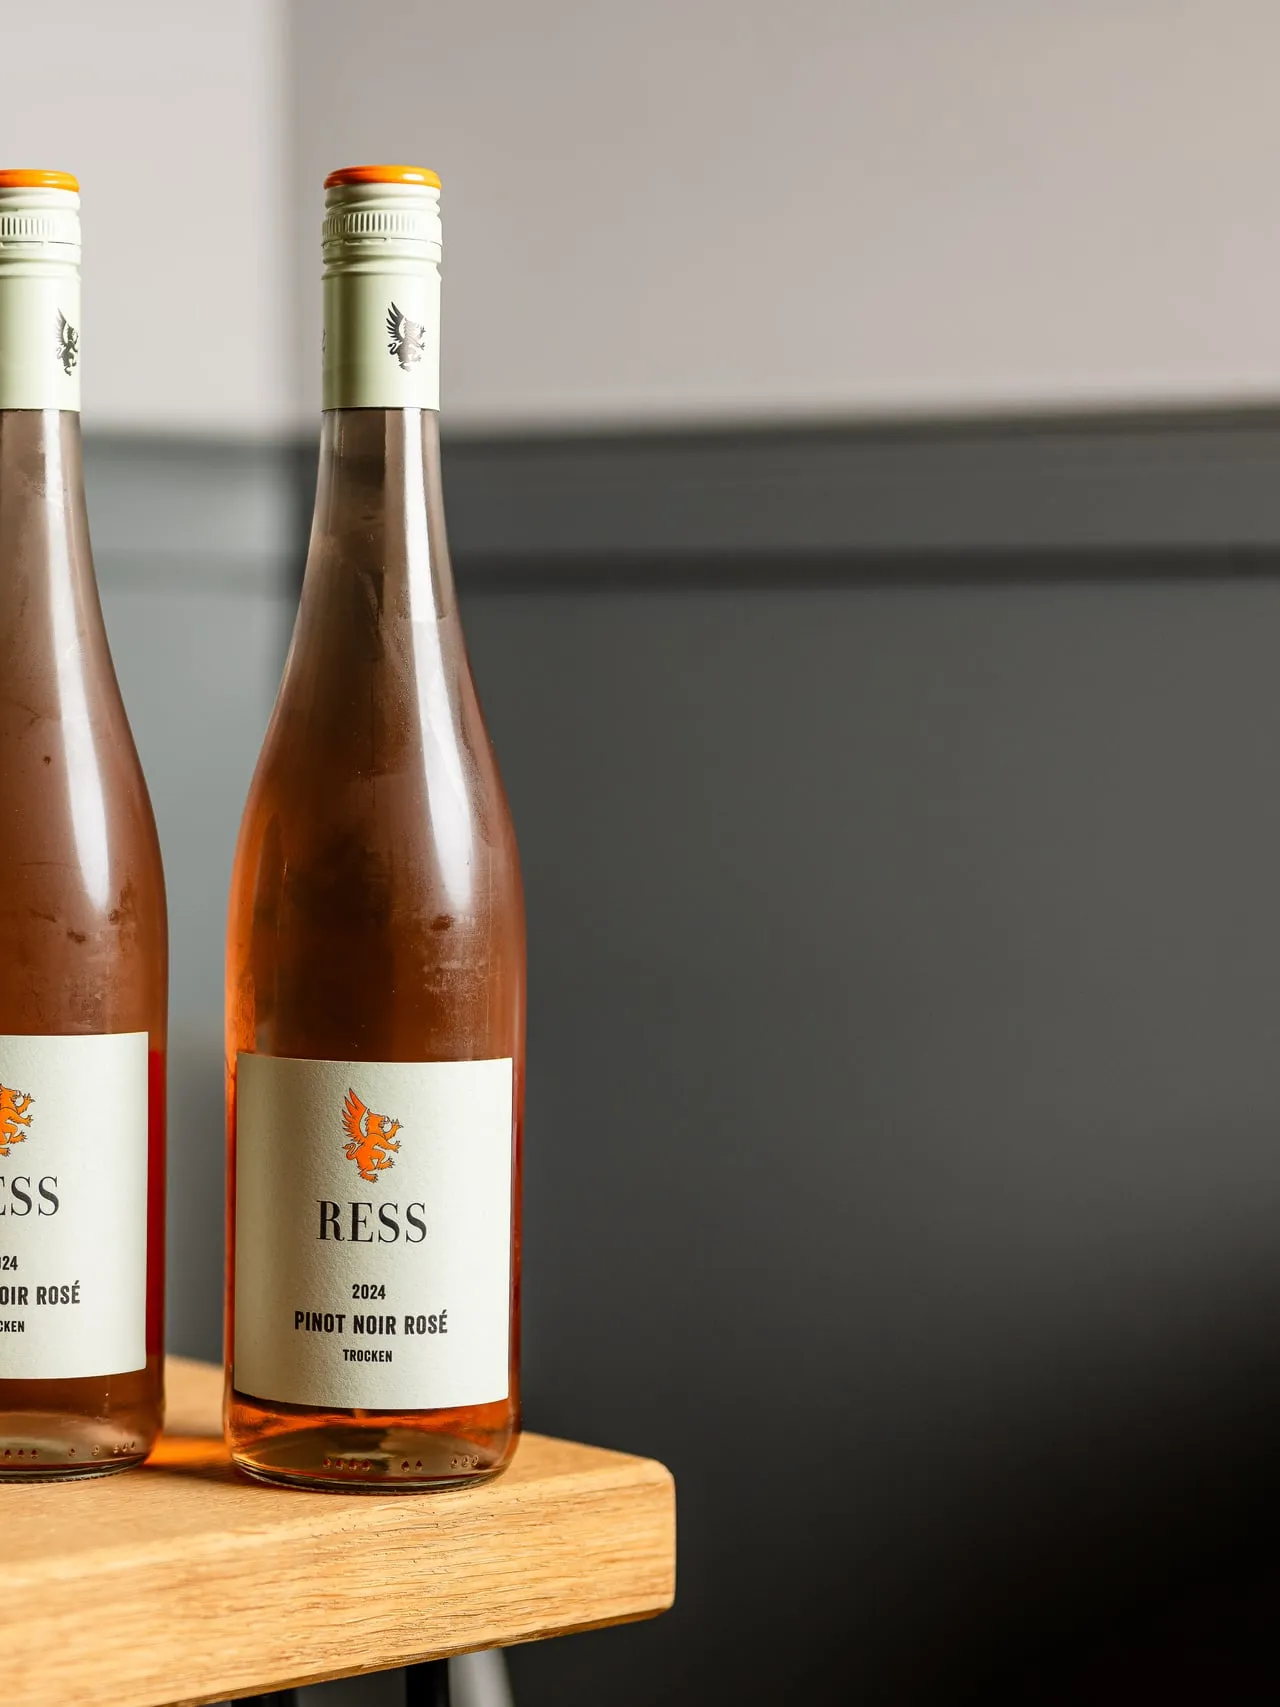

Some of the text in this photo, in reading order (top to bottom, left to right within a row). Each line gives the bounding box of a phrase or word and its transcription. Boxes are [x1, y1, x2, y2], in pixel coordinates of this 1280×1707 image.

[315, 1199, 427, 1244] RESS
[36, 1279, 81, 1306] ROSÉ
[351, 1283, 387, 1301] 2024
[294, 1308, 448, 1336] PINOT NOIR ROSÉ
[342, 1348, 393, 1363] TROCKEN
